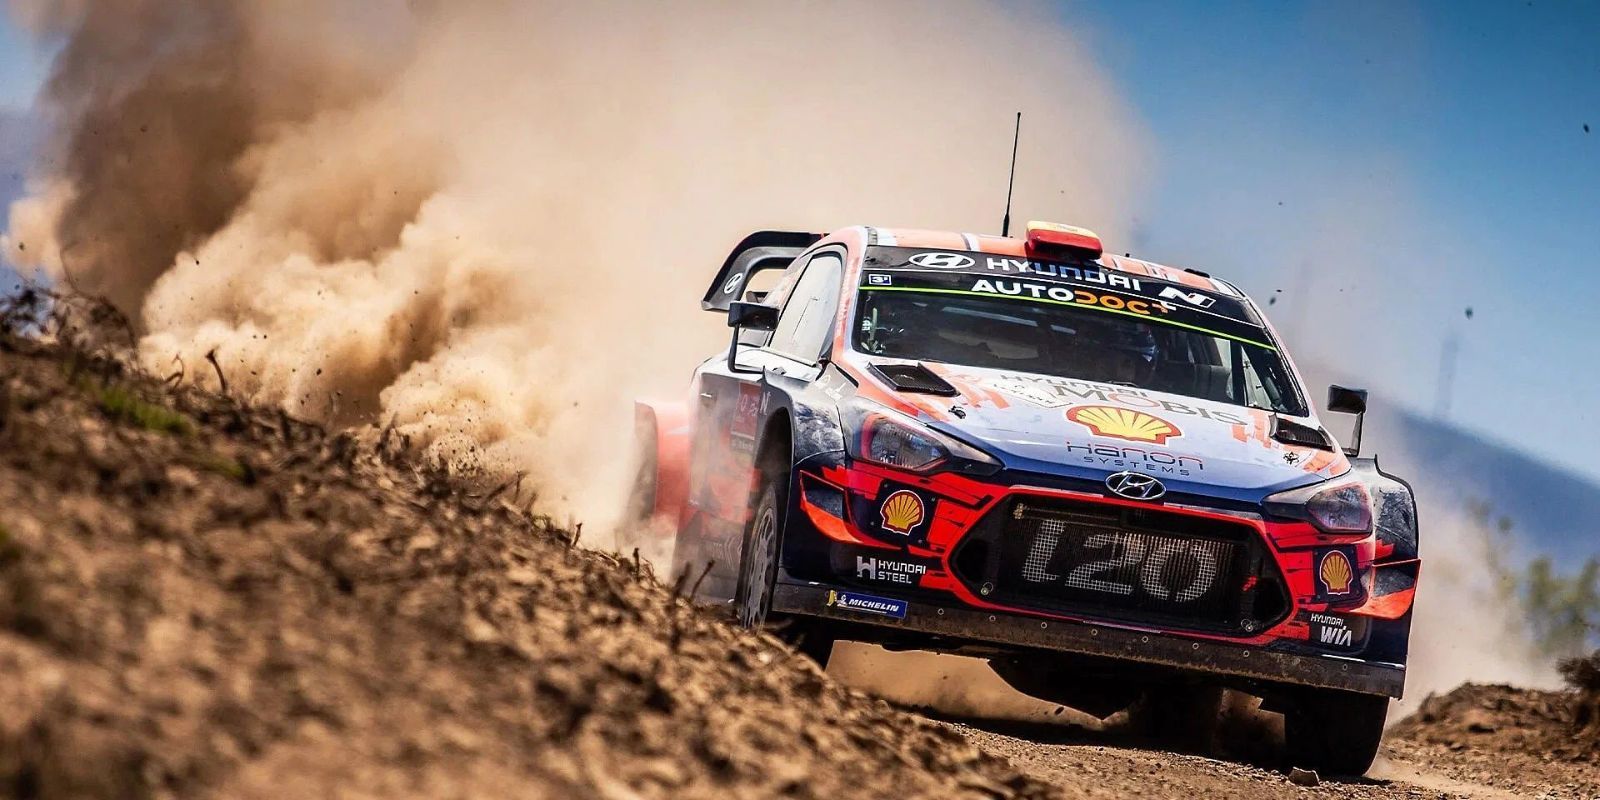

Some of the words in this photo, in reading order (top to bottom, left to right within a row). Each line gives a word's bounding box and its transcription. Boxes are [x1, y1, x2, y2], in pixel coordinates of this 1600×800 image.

[987, 257, 1141, 291] HYUNDAI
[1000, 374, 1148, 397] HYUNDAI
[1053, 385, 1248, 426] MOBIS
[1083, 456, 1190, 476] SYSTEMS
[878, 560, 926, 574] HYUNDAI
[878, 571, 912, 584] STEEL
[848, 599, 899, 612] MICHELIN
[1311, 613, 1344, 626] HYUNDAI
[1321, 626, 1352, 647] WIA
